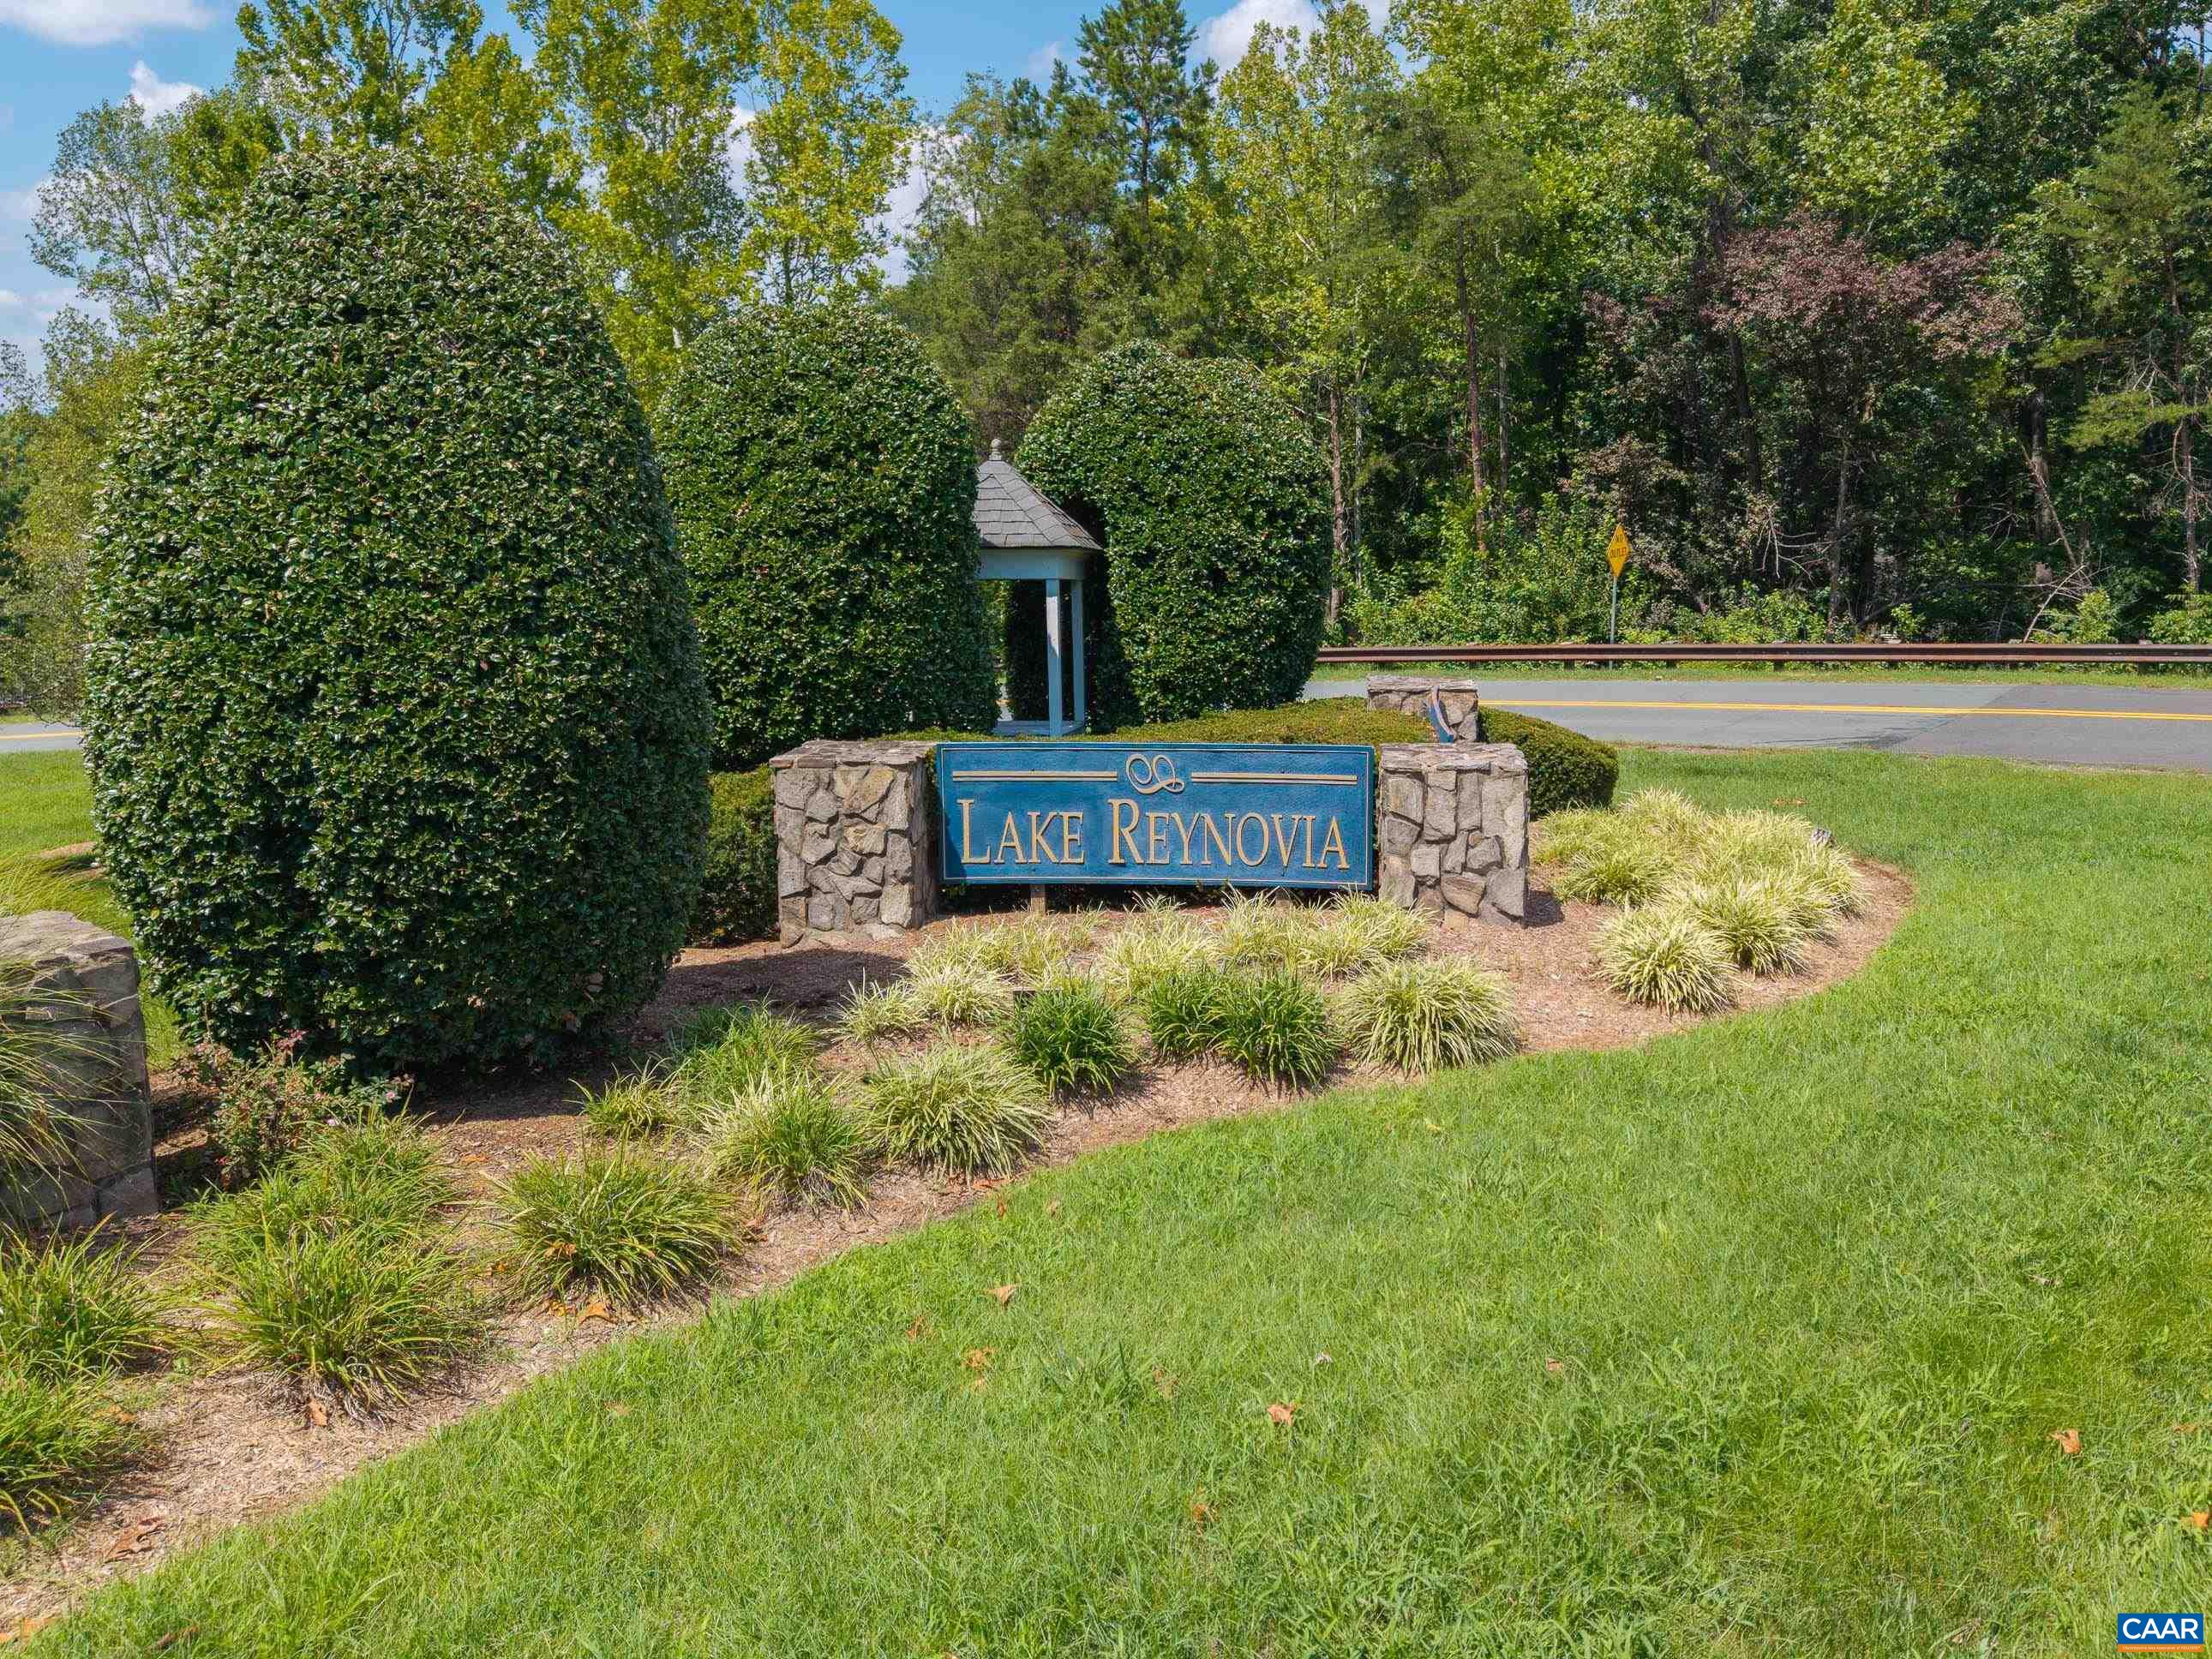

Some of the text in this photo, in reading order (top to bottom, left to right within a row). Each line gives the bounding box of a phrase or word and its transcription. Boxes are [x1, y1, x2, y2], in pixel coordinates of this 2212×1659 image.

[1616, 534, 1624, 542] NO
[1610, 547, 1627, 558] OUTLET
[956, 799, 1350, 870] LAKE REYNOVIA
